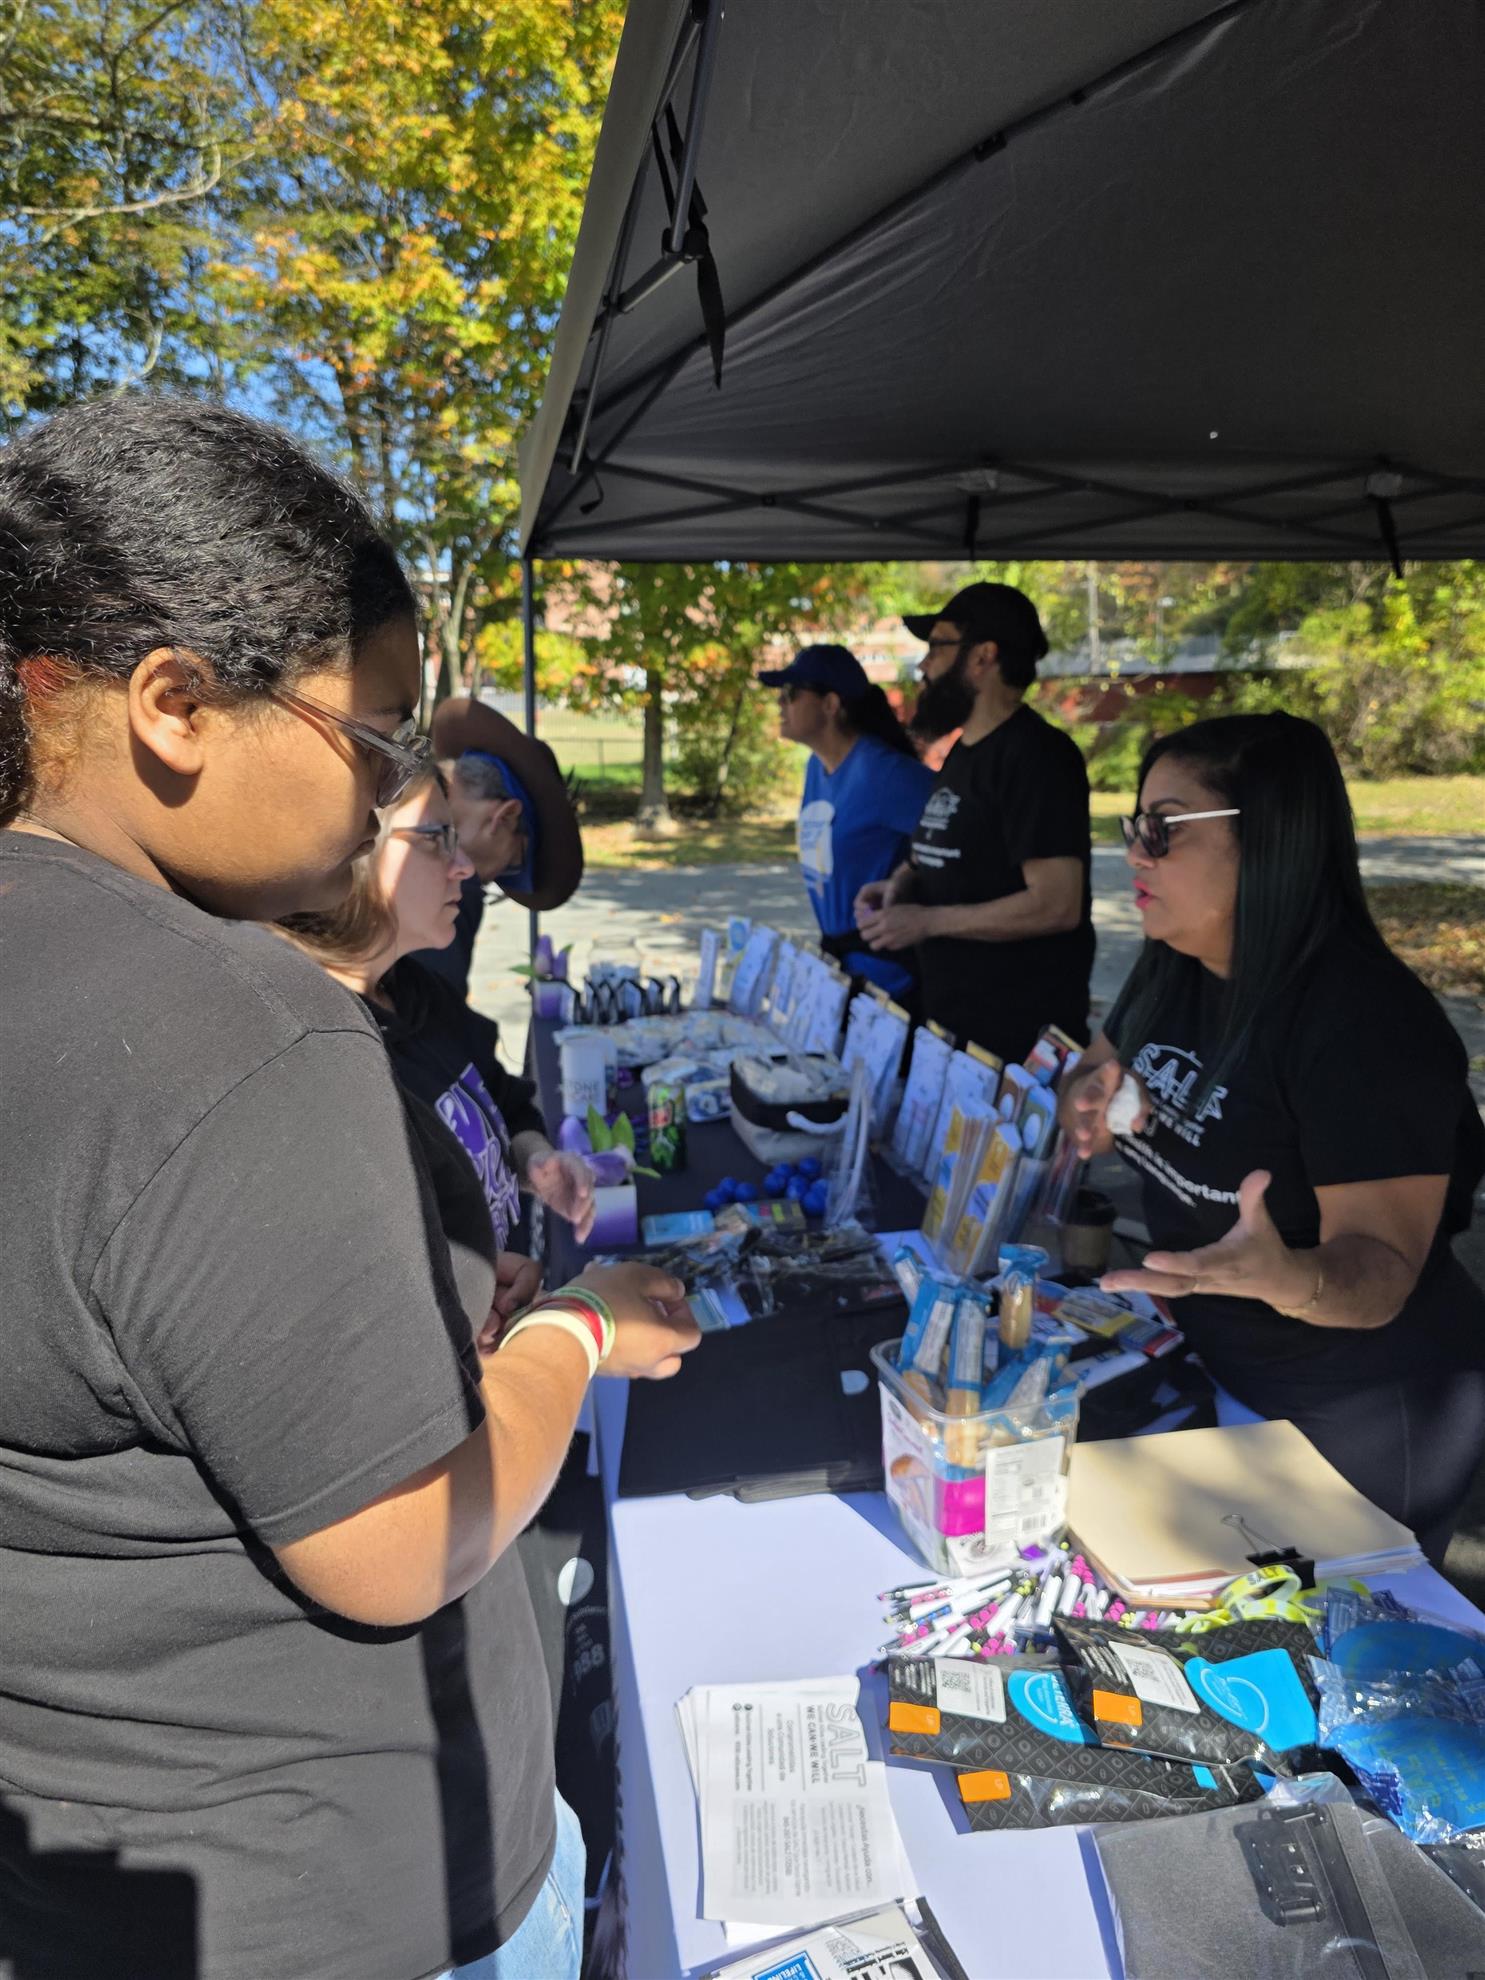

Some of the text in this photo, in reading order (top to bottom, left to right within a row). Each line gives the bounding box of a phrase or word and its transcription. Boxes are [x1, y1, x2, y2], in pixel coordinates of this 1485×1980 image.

[807, 1705, 815, 1720] WE
[811, 1761, 820, 1784] WILL
[825, 1702, 867, 1788] SALT
